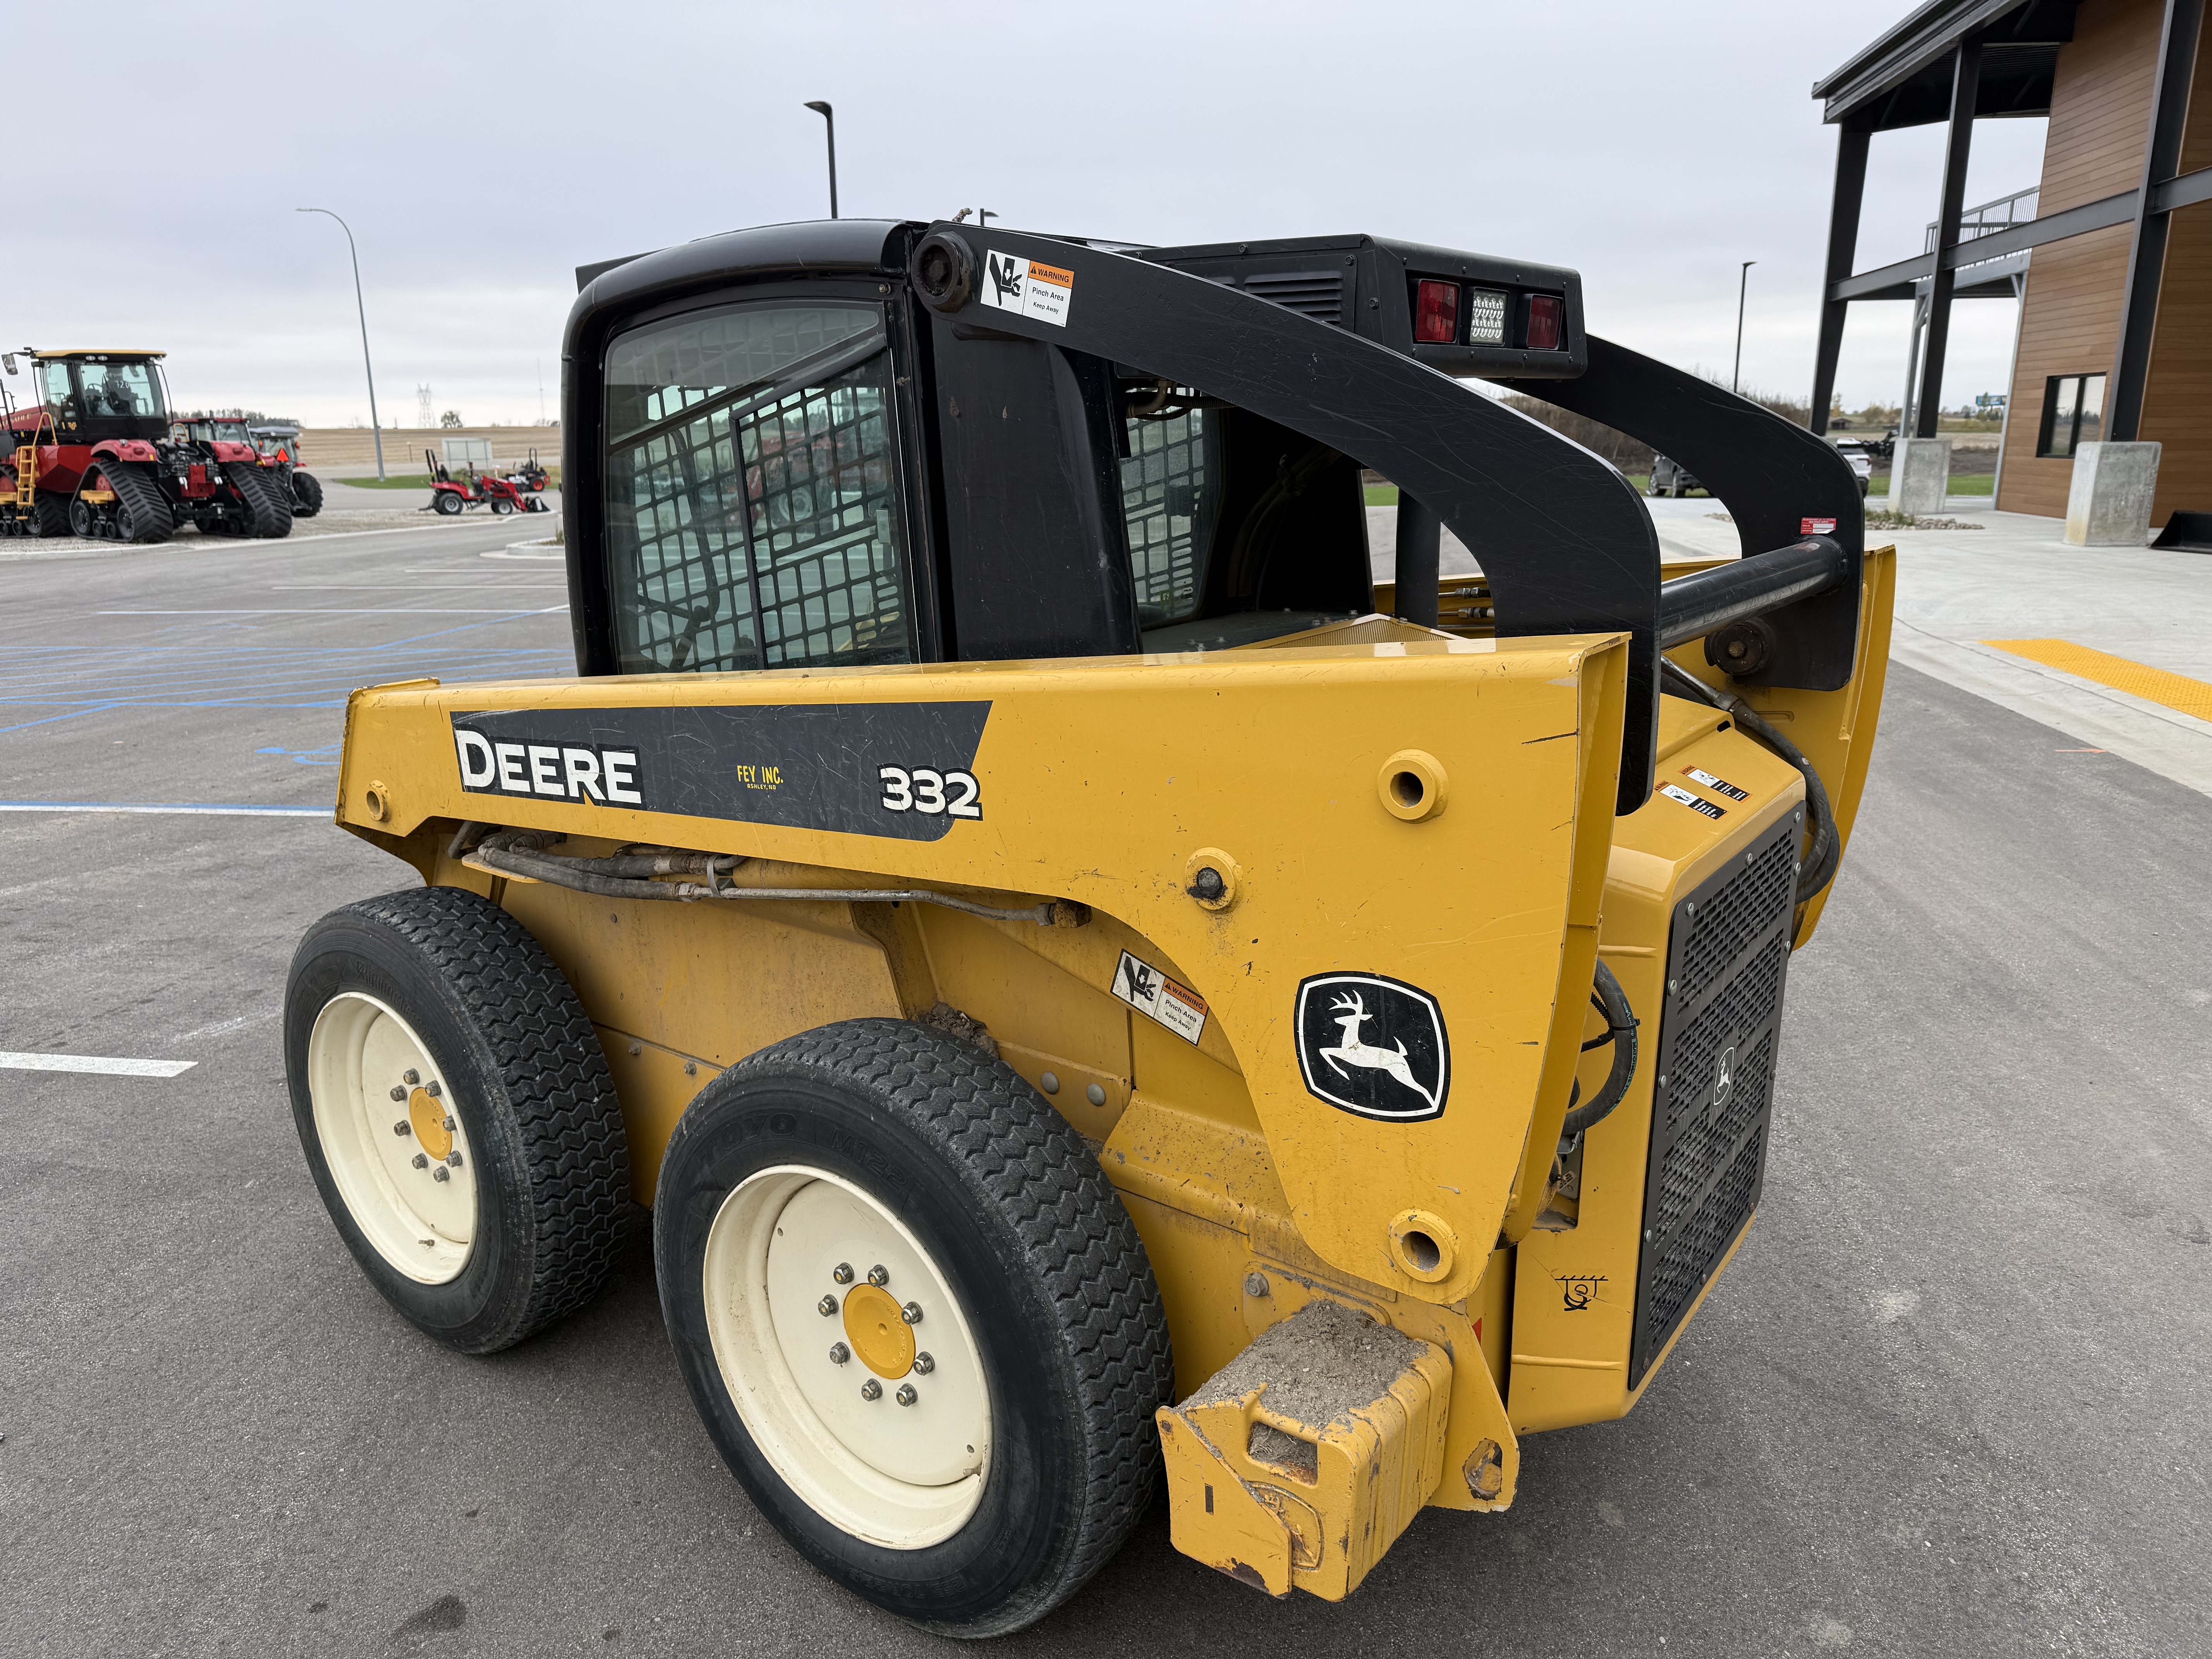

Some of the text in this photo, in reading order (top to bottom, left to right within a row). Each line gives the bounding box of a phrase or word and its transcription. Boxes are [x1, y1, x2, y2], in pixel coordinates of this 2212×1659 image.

[1038, 268, 1069, 283] WARNING
[1032, 287, 1064, 301] Pinch Area
[1033, 301, 1059, 314] Keep Away
[455, 730, 642, 804] DEERE
[737, 765, 784, 784] FEY INC.
[880, 767, 979, 817] 332
[1173, 986, 1204, 1010] WARNING
[1165, 1000, 1197, 1023] Pinch Area
[1165, 1011, 1191, 1031] Keep Away
[700, 1112, 797, 1166] TOYO
